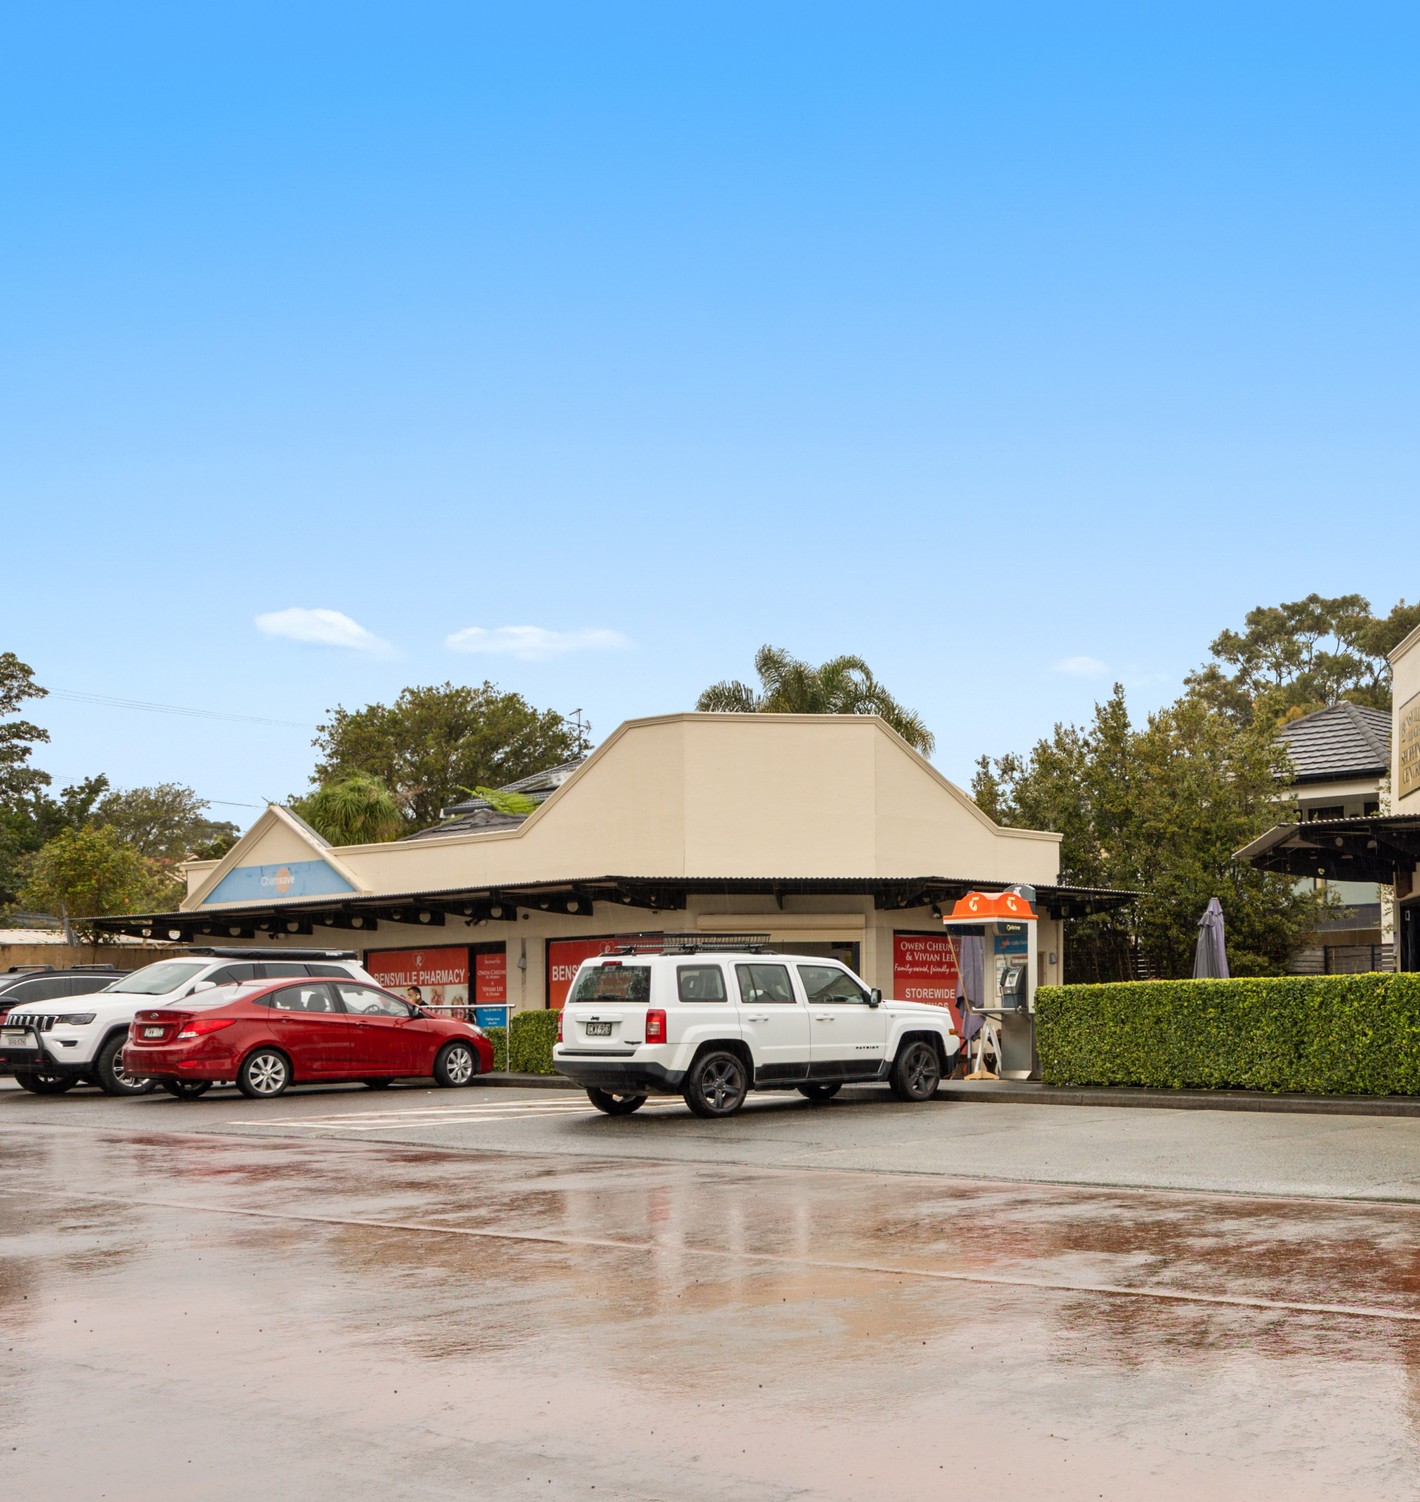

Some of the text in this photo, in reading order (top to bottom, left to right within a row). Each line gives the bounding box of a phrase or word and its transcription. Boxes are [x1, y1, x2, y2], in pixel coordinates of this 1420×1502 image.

[900, 941, 926, 951] OWEN
[913, 952, 940, 962] VIVIAN
[942, 952, 955, 962] LEE
[420, 969, 465, 984] PHARMACY
[905, 988, 955, 998] STOREWIDE
